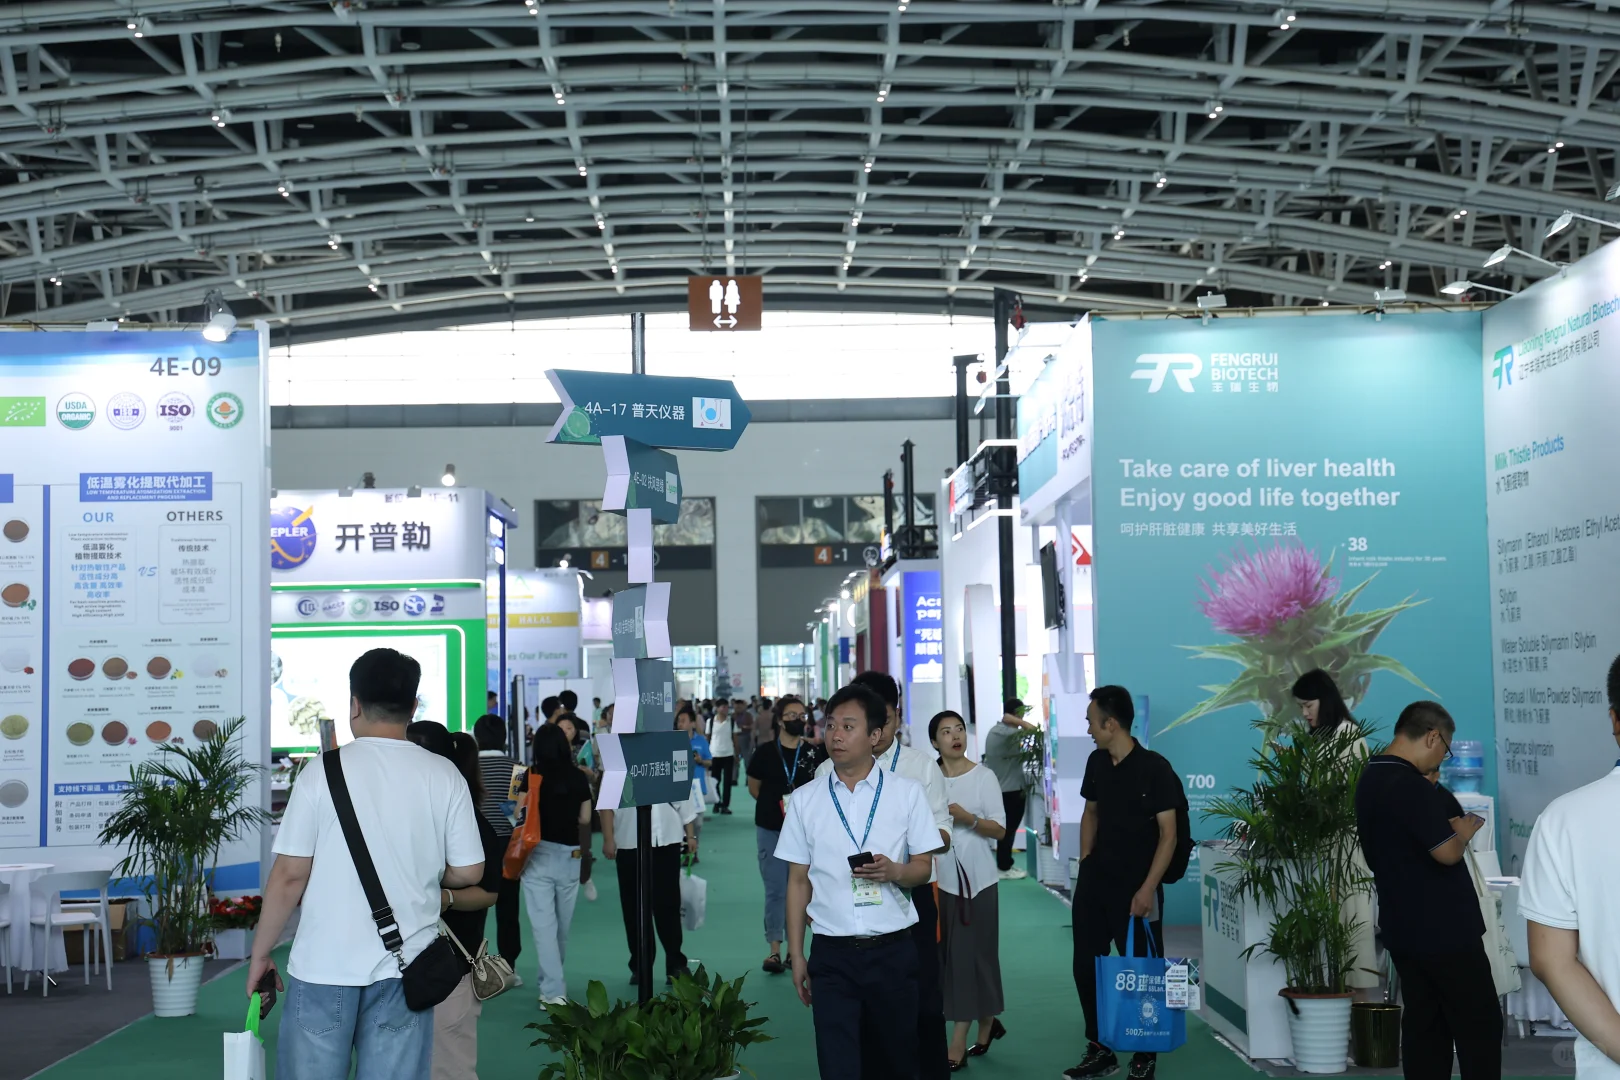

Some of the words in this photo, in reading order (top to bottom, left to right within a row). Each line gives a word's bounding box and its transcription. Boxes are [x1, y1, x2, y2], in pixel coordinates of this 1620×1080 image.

[1567, 306, 1592, 333] Natural
[149, 356, 222, 377] 4E-09
[1210, 353, 1278, 367] FENGRUI
[1211, 367, 1278, 381] BIOTECH
[65, 401, 87, 410] USDA
[160, 404, 191, 416] ISO
[584, 401, 627, 416] 4A-17
[631, 402, 685, 421] 普天仪器
[61, 412, 92, 421] ORGANIC
[1532, 433, 1564, 460] Products
[1119, 458, 1173, 478] Take
[1179, 461, 1230, 478] care
[1236, 458, 1261, 478] of
[1266, 458, 1317, 478] liver
[1323, 457, 1396, 478] health
[87, 475, 206, 490] 低温雾化提取代加工
[1120, 487, 1187, 512] Enjoy
[1193, 487, 1254, 511] good
[1260, 487, 1294, 507] life
[1301, 487, 1400, 511] together
[82, 511, 115, 523] OUR
[166, 510, 224, 522] OTHERS
[269, 526, 308, 537] EPLER
[335, 520, 431, 552] 开普勒
[1120, 522, 1205, 536] 呵护肝脏健康
[1212, 521, 1297, 536] 共享美好生活
[1554, 525, 1581, 542] Acetone
[82, 543, 115, 551] 低温雾化
[178, 544, 209, 552] 传统技术
[1347, 536, 1368, 552] 38
[75, 552, 122, 560] 植物提取技术
[138, 566, 158, 577] VS
[374, 601, 400, 611] ISO
[519, 652, 535, 660] Our
[538, 651, 568, 659] Future
[1547, 687, 1571, 704] Powder
[1572, 687, 1603, 708] Silymarin
[1505, 738, 1527, 758] Organic
[630, 763, 648, 778] 4D-07
[649, 761, 670, 777] 万源生物
[1186, 774, 1216, 789] 700
